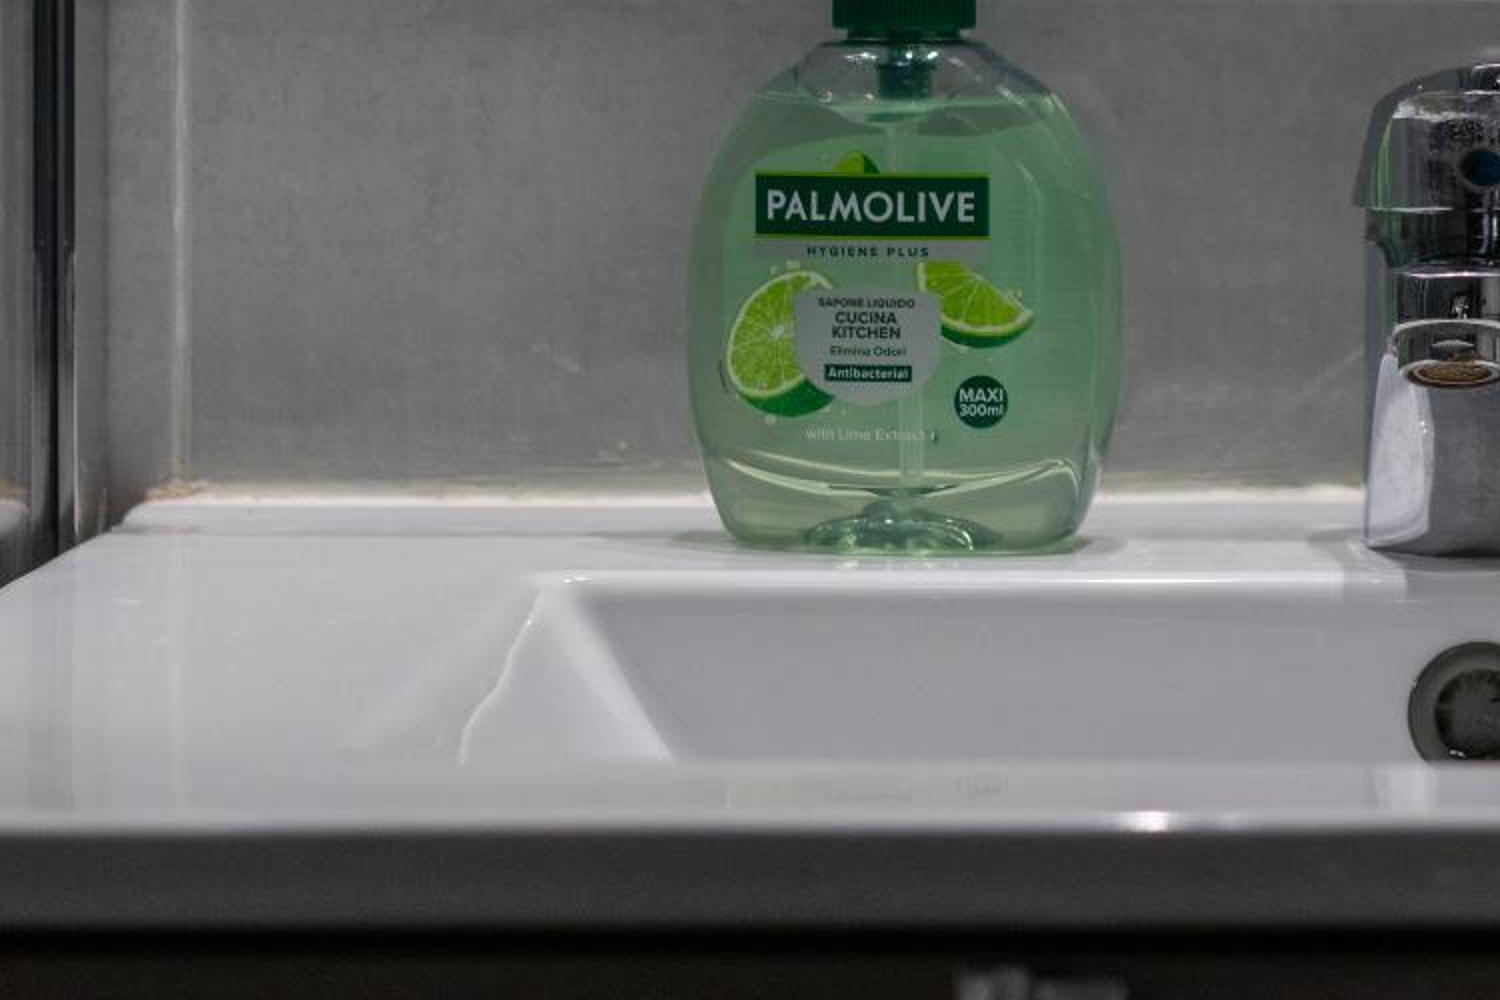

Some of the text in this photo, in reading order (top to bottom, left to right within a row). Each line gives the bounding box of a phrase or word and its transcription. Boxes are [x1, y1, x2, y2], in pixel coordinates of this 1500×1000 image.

[766, 188, 976, 224] PALMOLIVE
[807, 247, 929, 257] HYGIENE PLUS
[818, 298, 915, 308] SAPONE LIQUIDO
[835, 312, 897, 324] CUCINA
[832, 326, 901, 339] KITCHEN
[828, 366, 910, 379] Antibacterial
[959, 388, 1003, 402] MAXI
[959, 403, 1004, 416] 300ml
